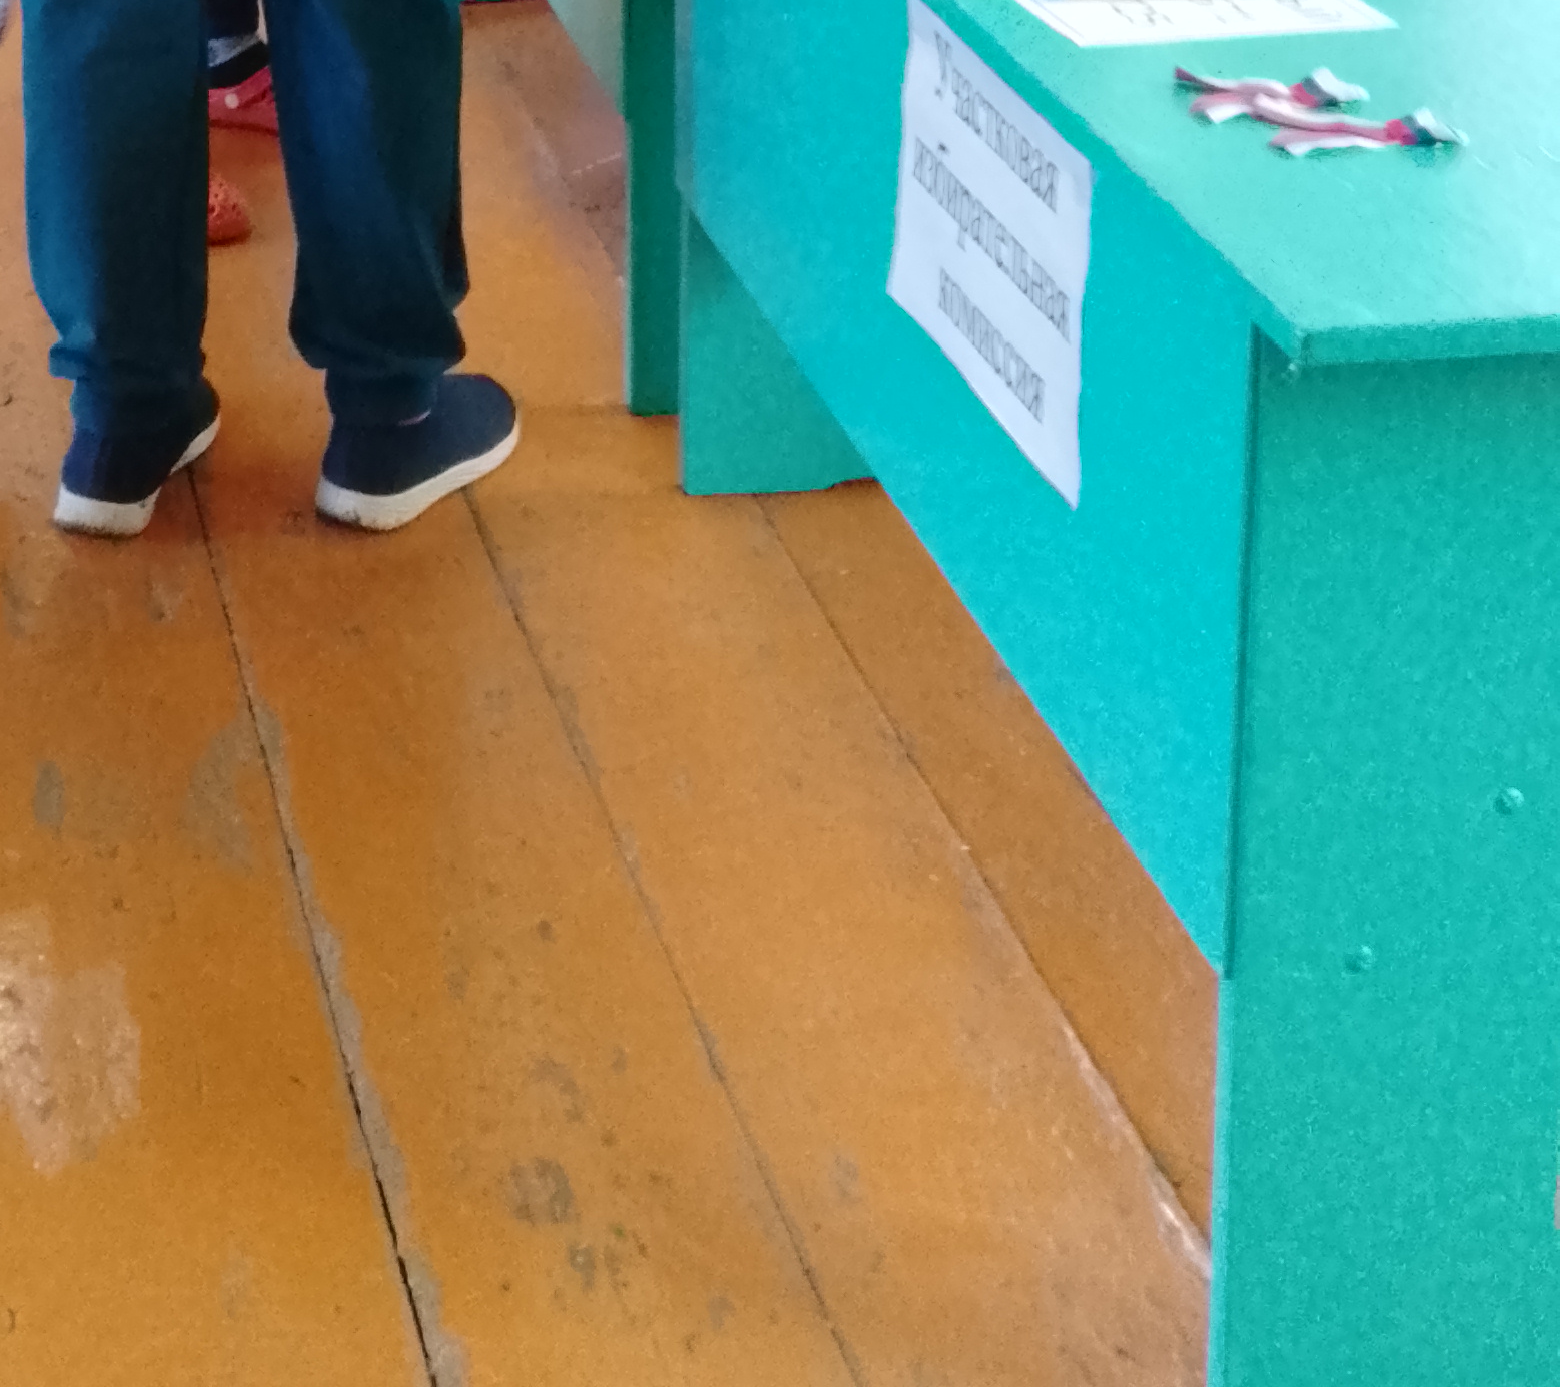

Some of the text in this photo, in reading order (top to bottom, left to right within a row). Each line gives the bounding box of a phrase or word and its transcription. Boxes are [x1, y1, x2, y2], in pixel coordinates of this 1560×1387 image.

[934, 31, 1059, 214] Участковая
[913, 136, 1071, 344] избирательная
[939, 267, 1045, 425] комиссия
